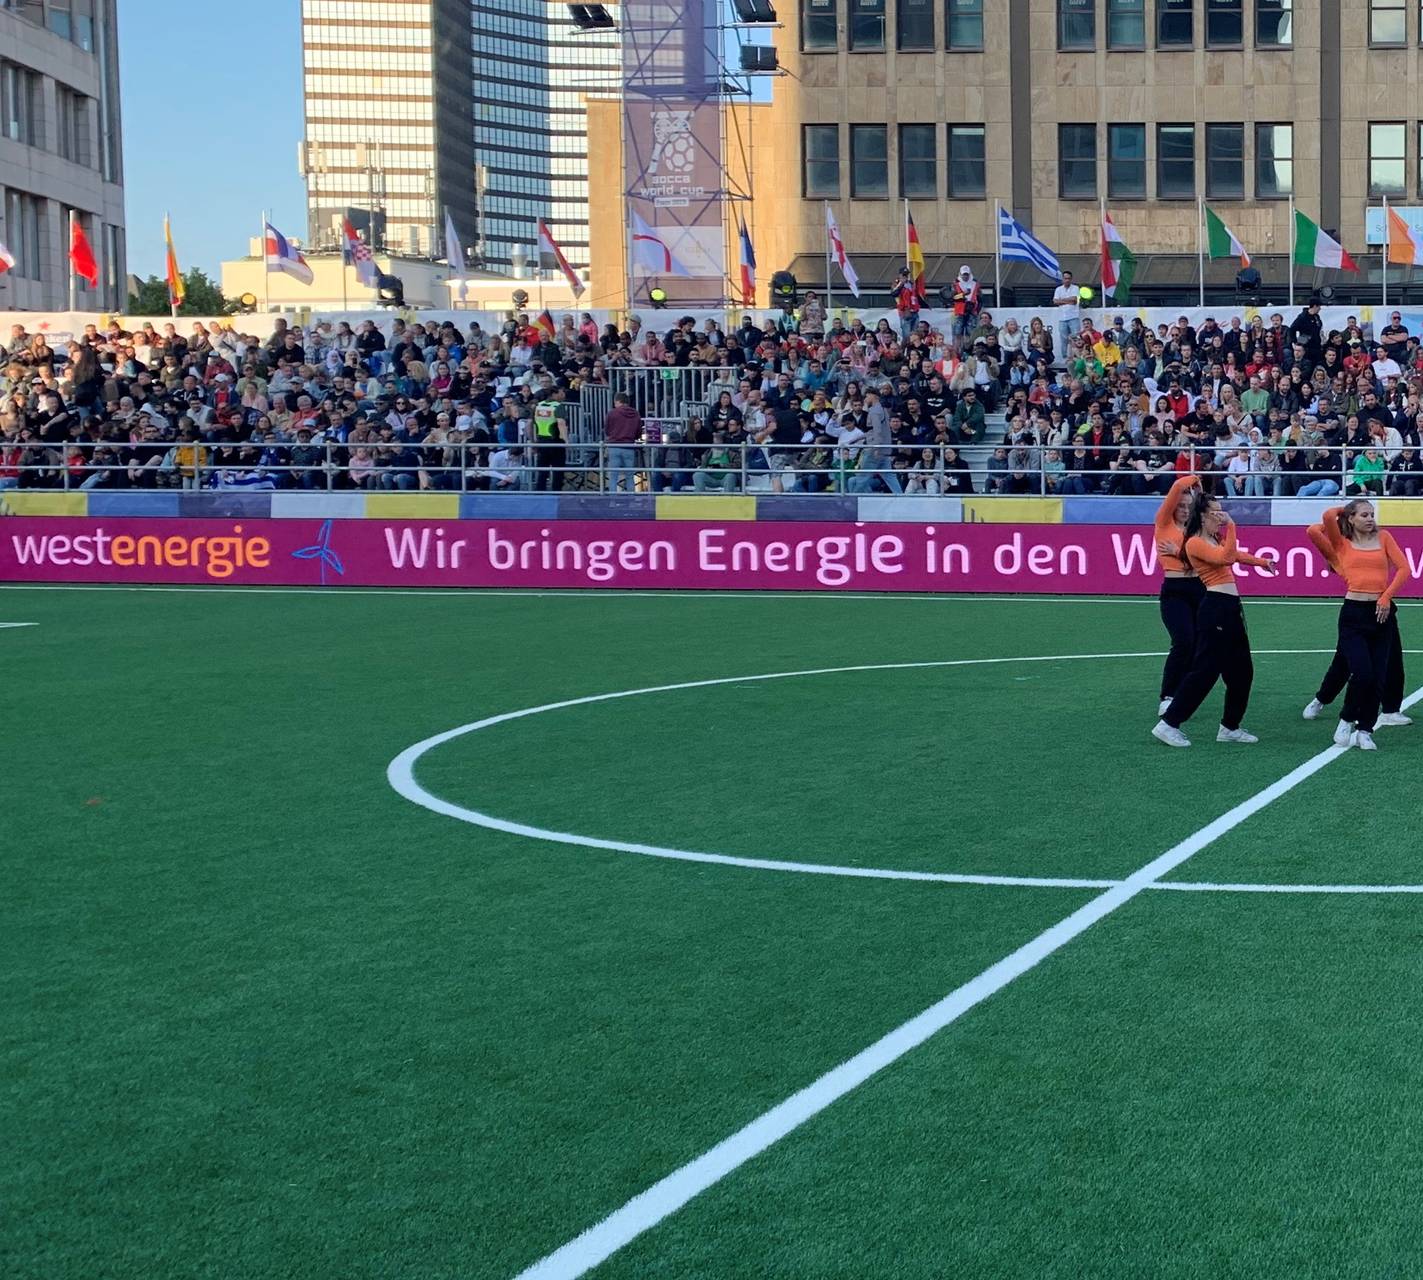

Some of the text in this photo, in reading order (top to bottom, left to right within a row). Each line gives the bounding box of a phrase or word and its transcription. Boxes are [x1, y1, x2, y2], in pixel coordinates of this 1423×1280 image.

[651, 175, 691, 184] socca
[640, 185, 704, 197] world cup
[12, 525, 270, 577] westenergie
[384, 526, 465, 569] Wir
[488, 528, 675, 582] bringen
[699, 522, 903, 585] Energie
[926, 527, 969, 573] in
[994, 533, 1087, 576] den
[1111, 533, 1328, 577] Wten.
